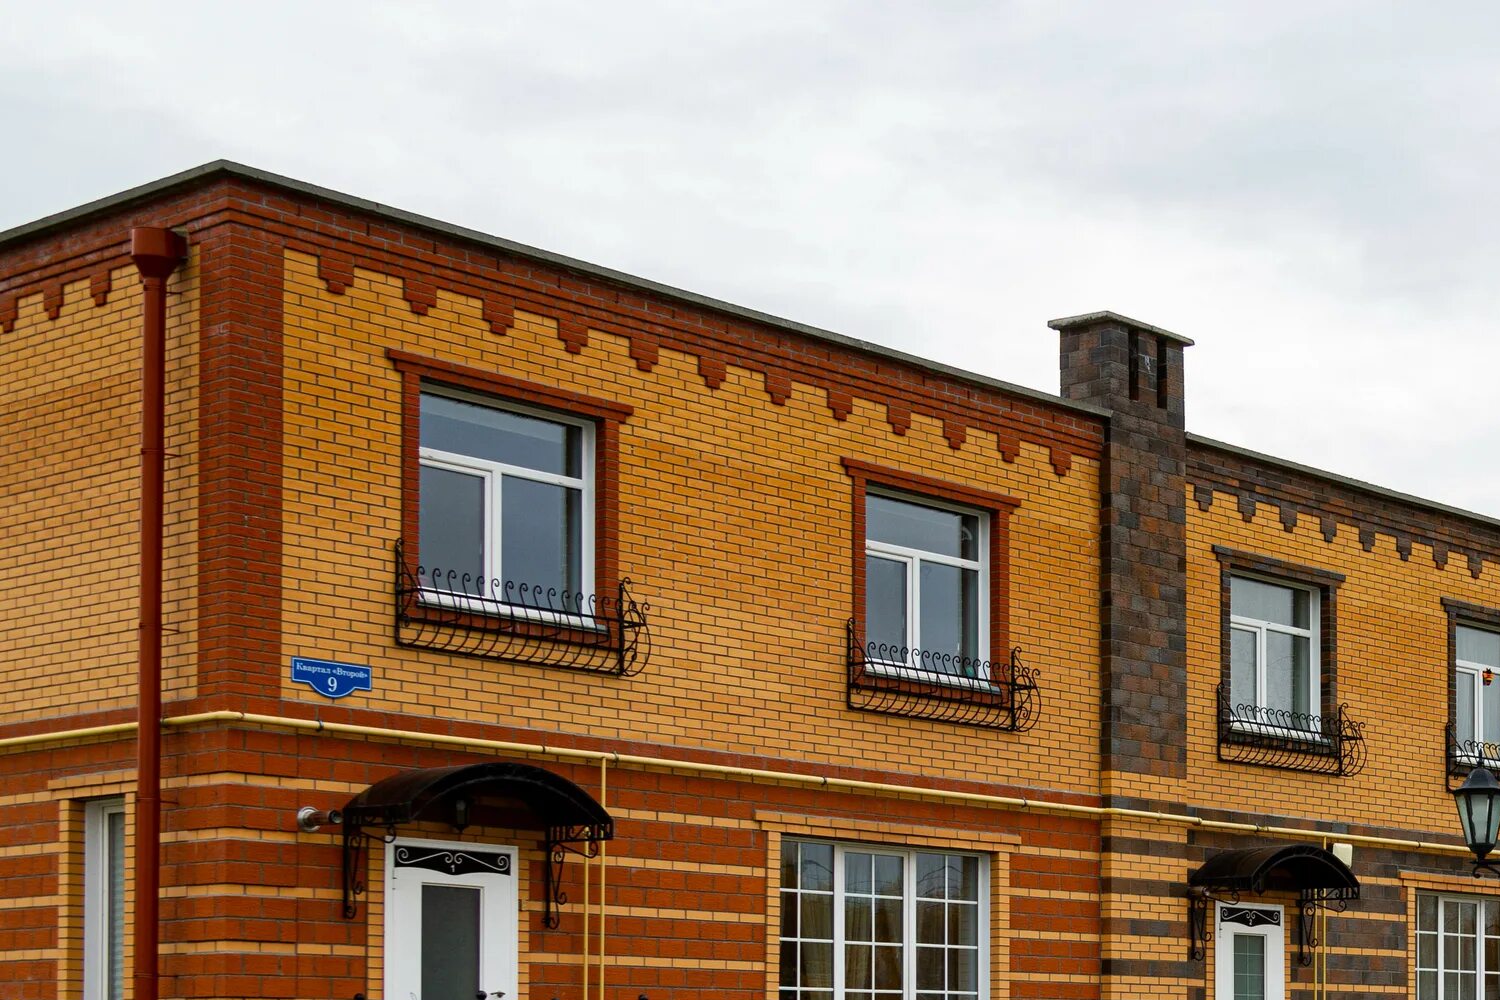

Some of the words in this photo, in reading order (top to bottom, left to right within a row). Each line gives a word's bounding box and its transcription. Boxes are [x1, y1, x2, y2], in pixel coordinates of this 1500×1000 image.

[296, 662, 331, 674] Квартал
[332, 667, 368, 679] «Второй»
[327, 676, 338, 692] 9
[450, 864, 455, 873] 1
